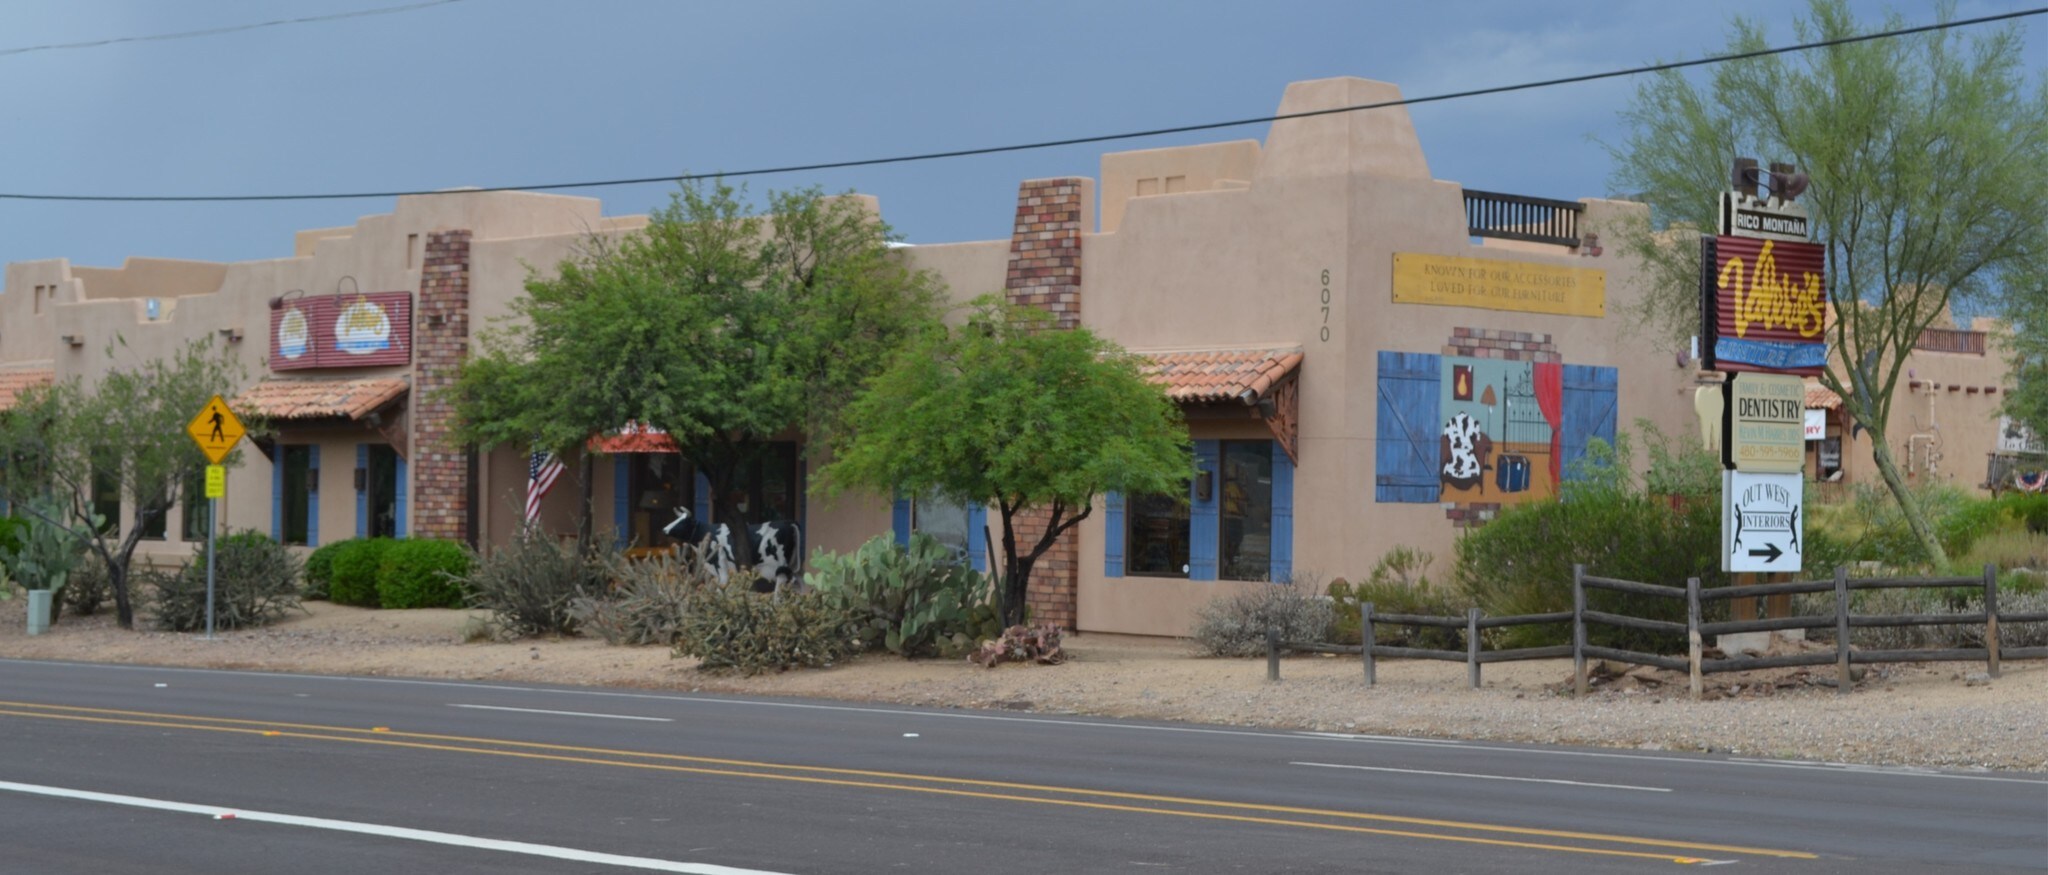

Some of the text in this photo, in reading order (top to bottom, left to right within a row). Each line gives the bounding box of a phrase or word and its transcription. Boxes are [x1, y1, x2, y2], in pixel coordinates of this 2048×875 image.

[1737, 213, 1807, 236] RICO MONTAÑA
[1424, 264, 1577, 288] KNOWN FOR OUR ACCESSORIES
[1430, 281, 1566, 303] LOVED FOR OUR FURNITURE
[1320, 269, 1331, 342] 6070
[1739, 398, 1801, 419] DENTISTRY
[1805, 426, 1820, 434] RY
[1742, 483, 1791, 508] OUT WEST
[1742, 514, 1791, 529] INTERIORS
